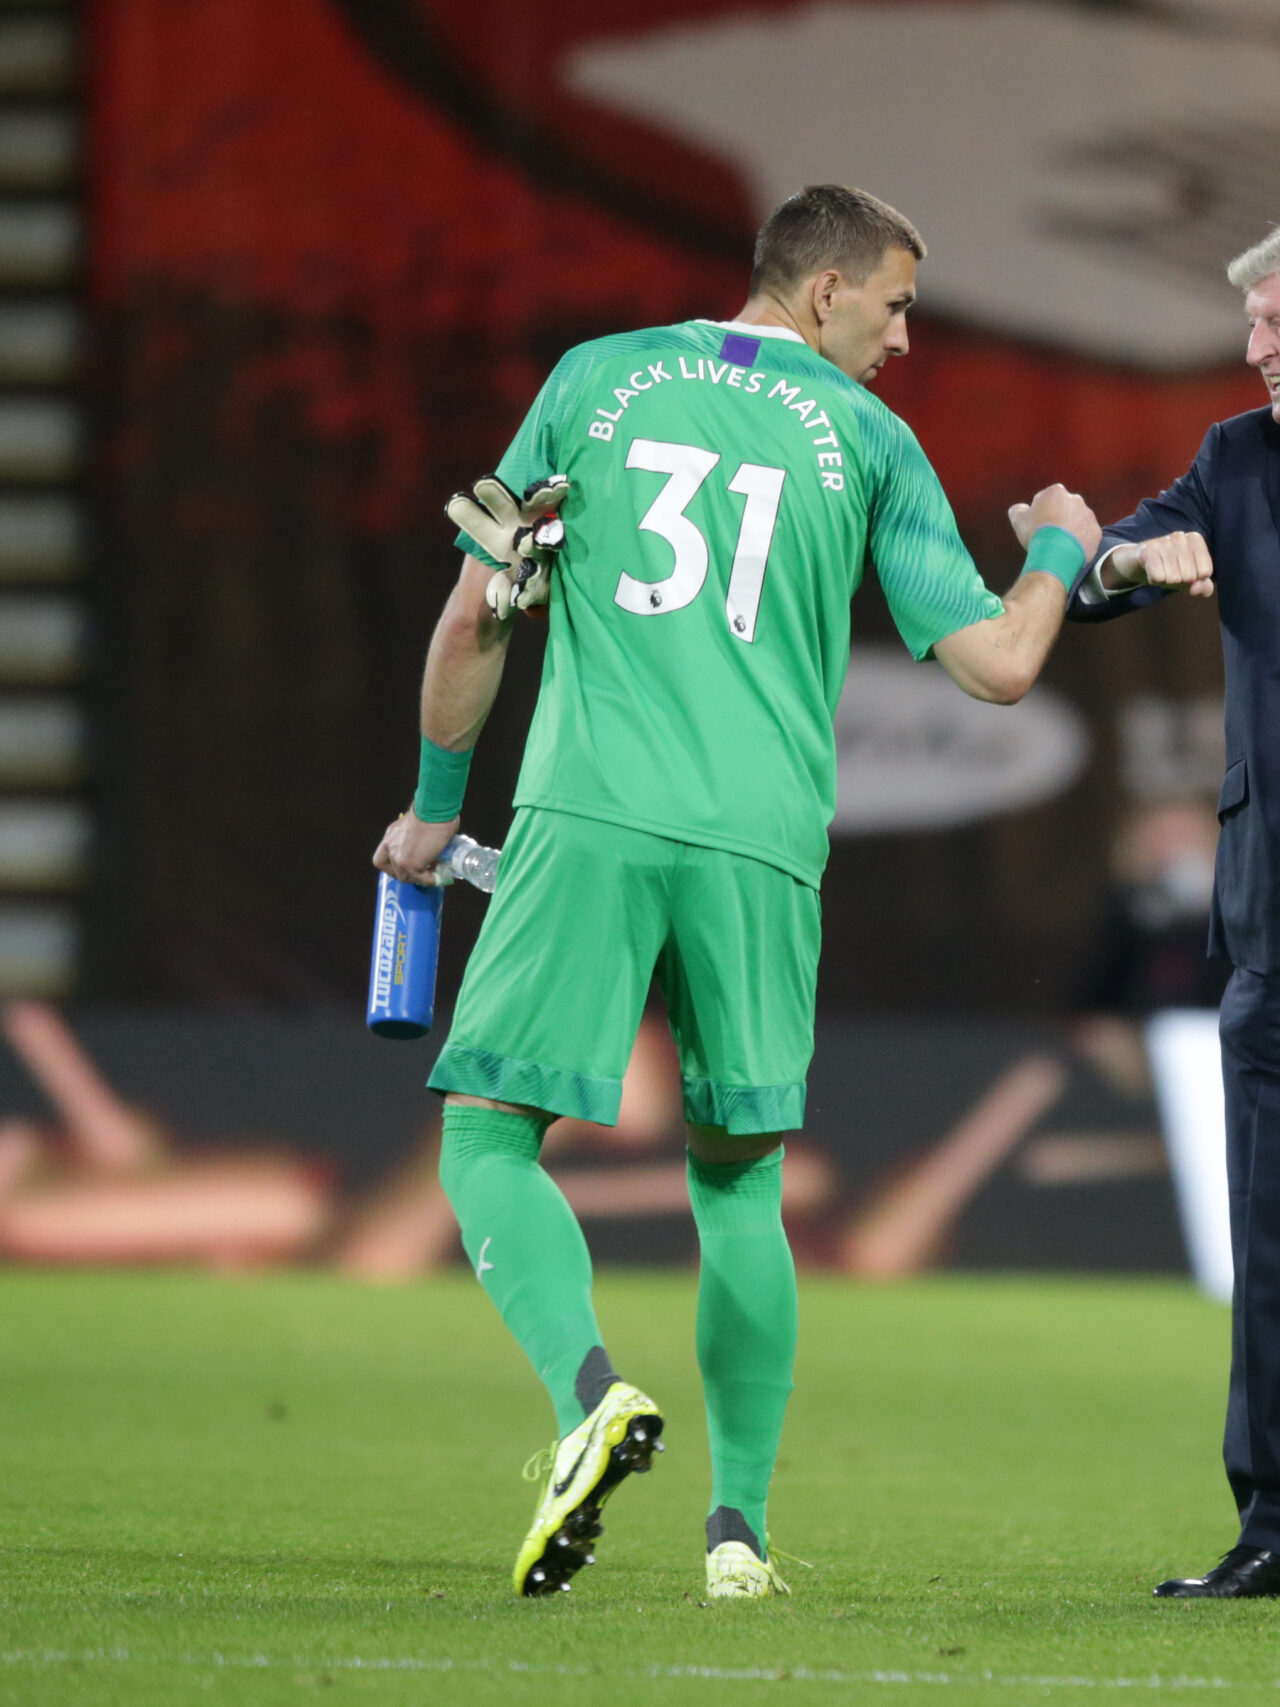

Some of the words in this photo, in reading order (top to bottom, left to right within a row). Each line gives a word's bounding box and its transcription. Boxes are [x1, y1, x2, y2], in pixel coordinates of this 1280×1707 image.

[588, 361, 672, 442] BLACK
[679, 356, 766, 394] LIVES
[767, 379, 845, 491] MATTER
[613, 437, 787, 644] 31
[394, 931, 407, 985] SPORT
